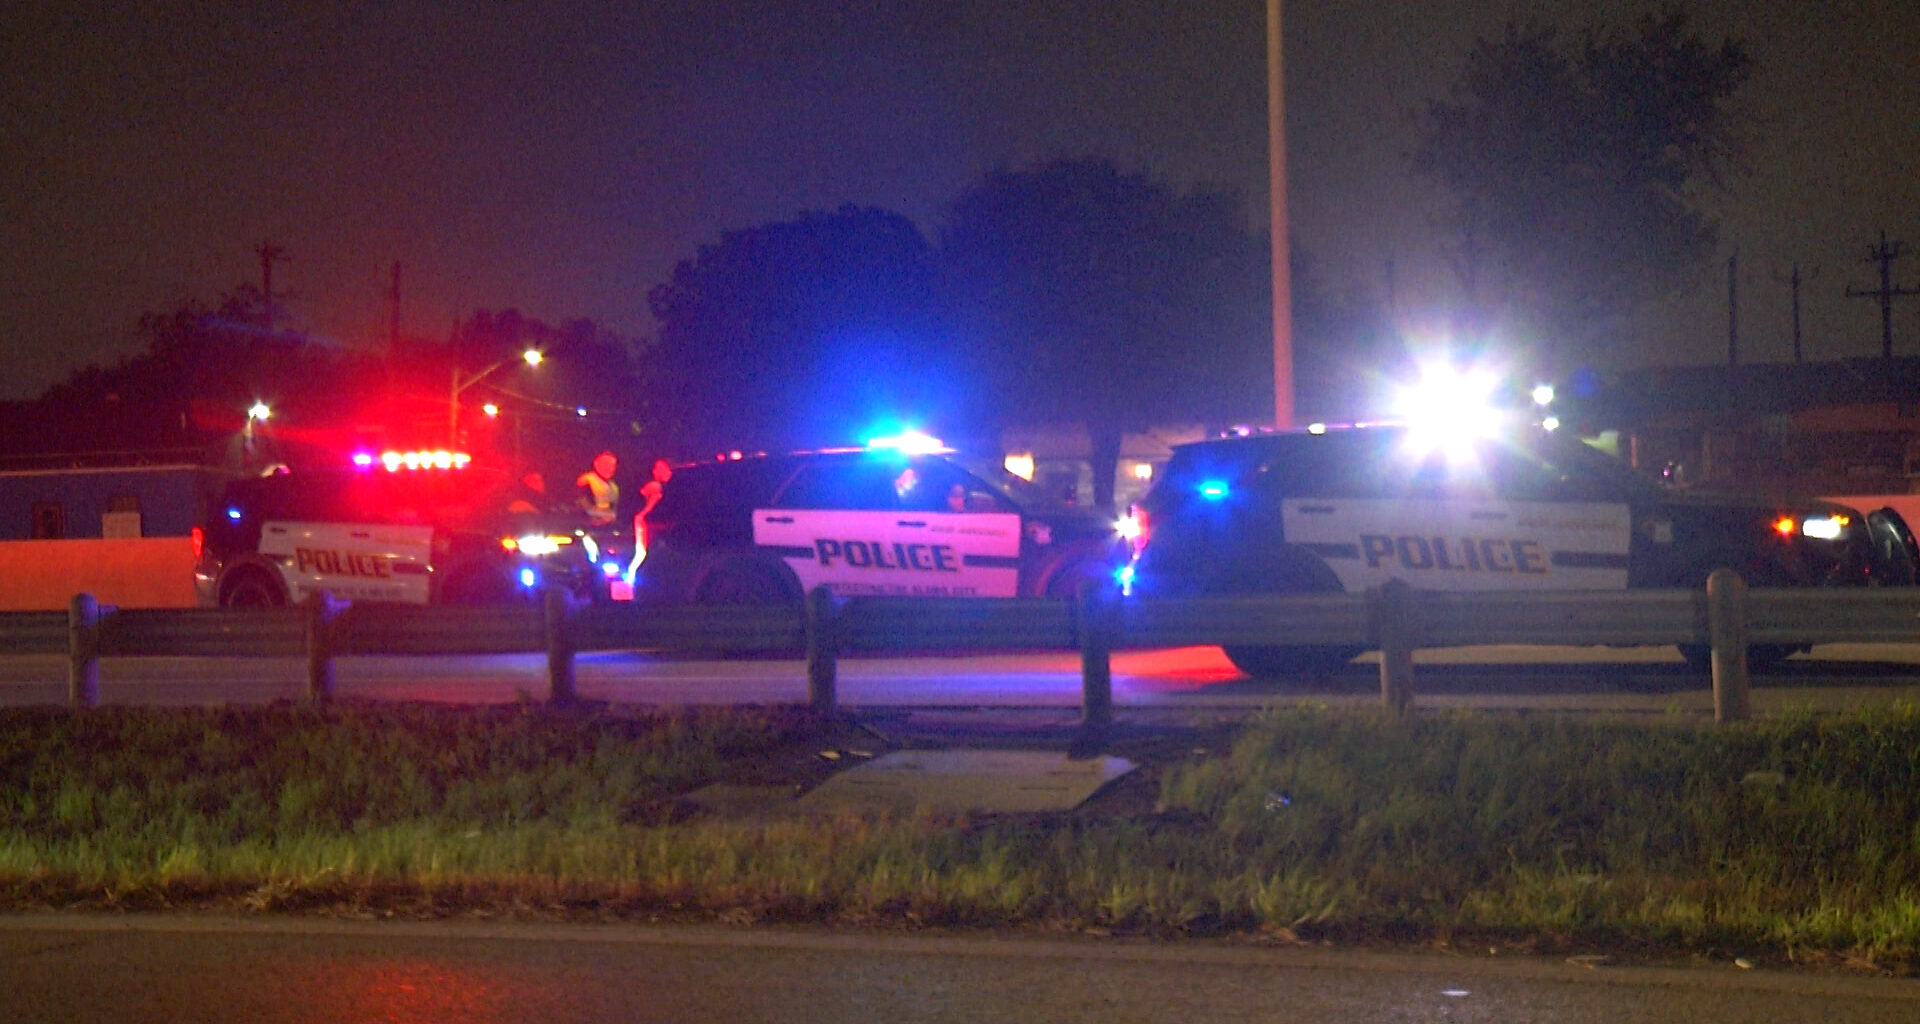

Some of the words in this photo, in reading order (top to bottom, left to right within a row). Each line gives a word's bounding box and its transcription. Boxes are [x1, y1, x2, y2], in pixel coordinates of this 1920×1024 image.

[295, 547, 391, 578] POLICE
[814, 538, 958, 573] POLICE
[1360, 534, 1548, 575] POLICE
